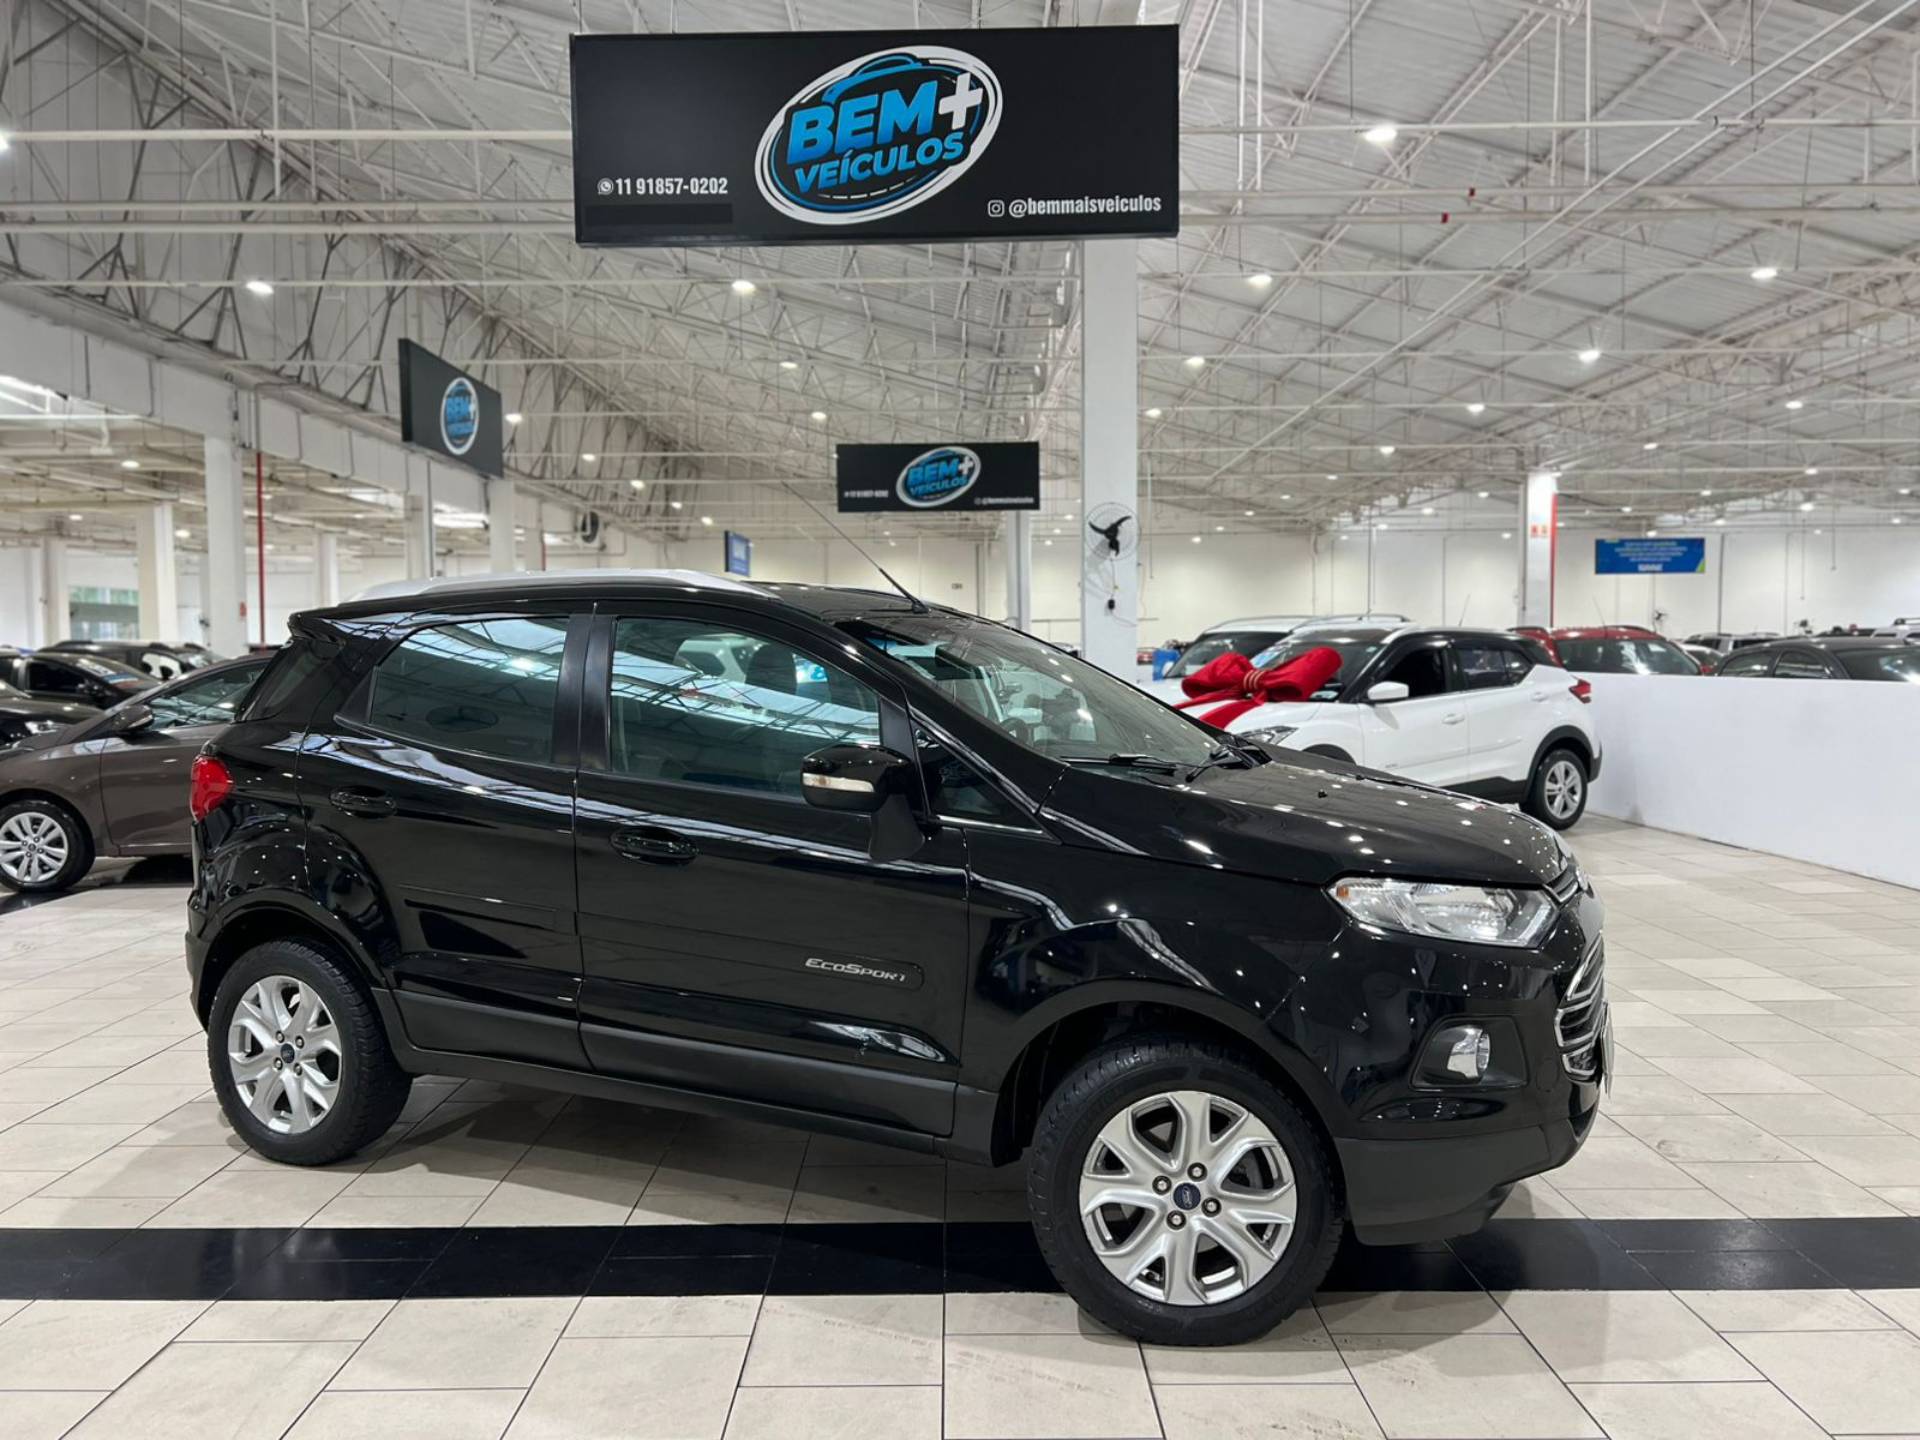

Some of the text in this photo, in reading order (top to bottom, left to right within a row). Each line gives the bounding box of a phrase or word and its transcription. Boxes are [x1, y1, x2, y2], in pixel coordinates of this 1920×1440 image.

[794, 131, 965, 192] VEÍCULOS
[616, 177, 728, 195] 11 91857-0202
[1008, 195, 1162, 218] @bemmaisveiculos
